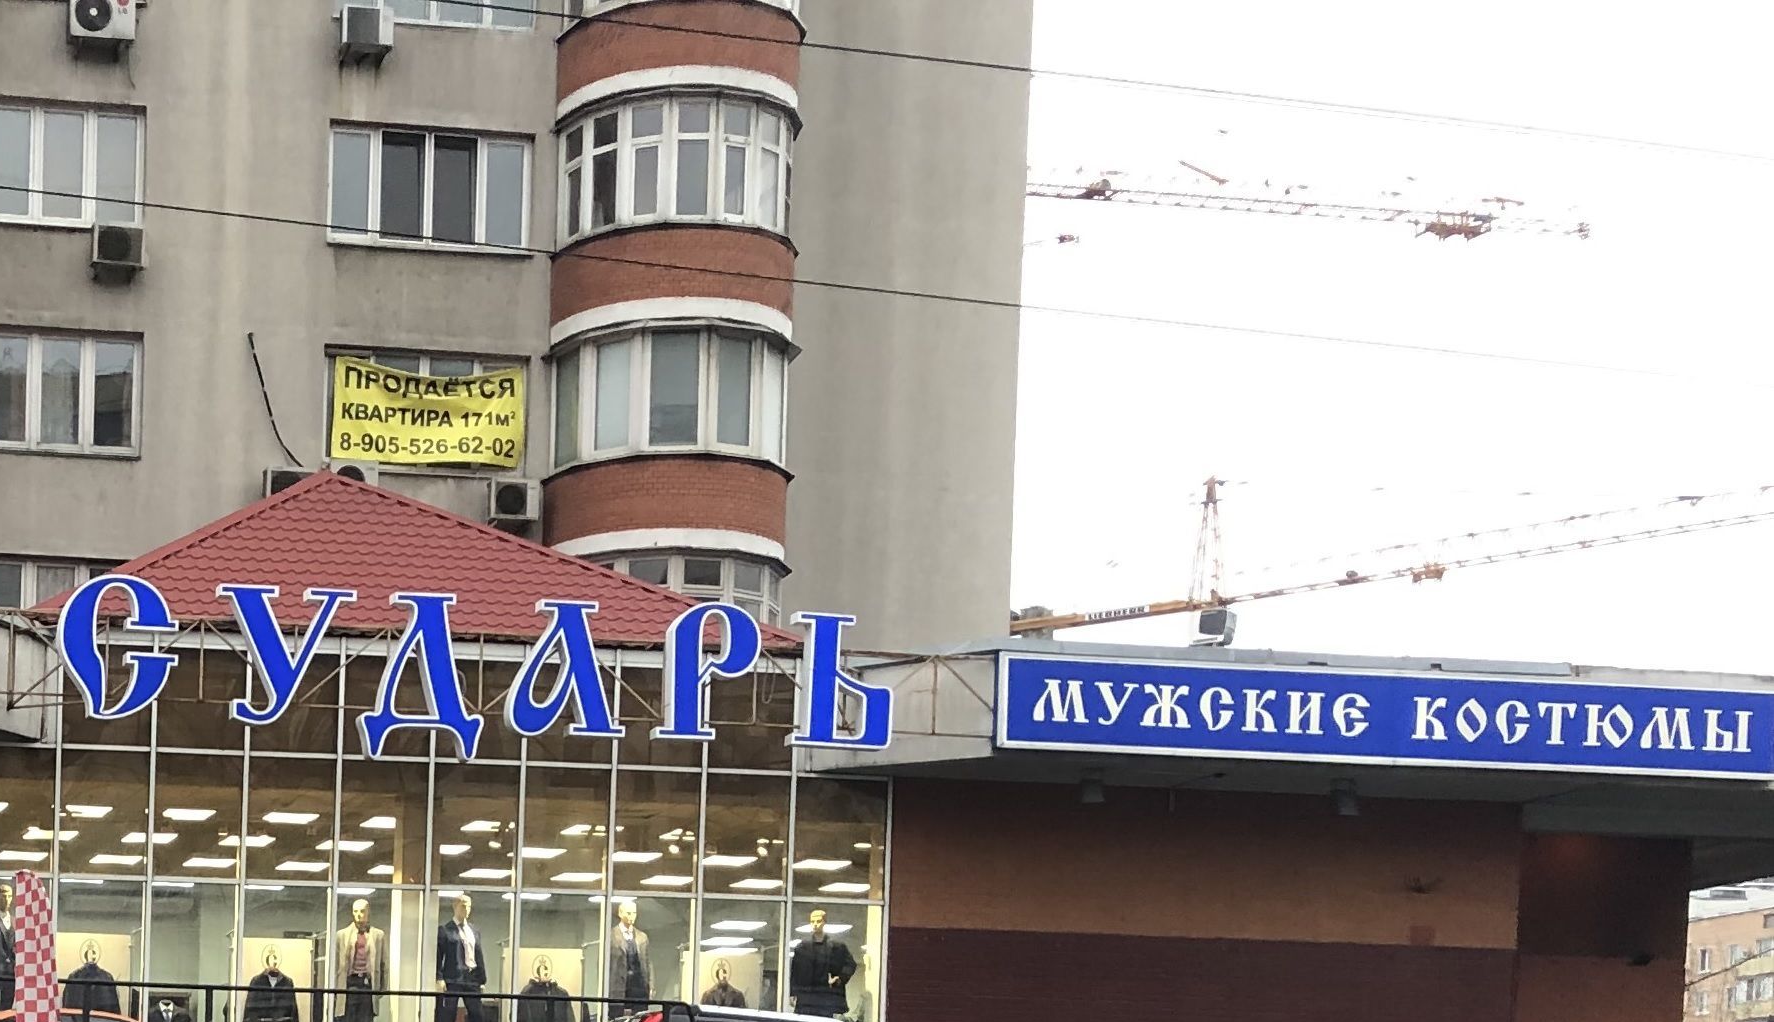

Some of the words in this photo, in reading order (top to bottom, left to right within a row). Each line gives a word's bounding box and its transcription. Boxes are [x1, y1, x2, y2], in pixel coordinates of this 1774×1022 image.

[344, 366, 515, 399] ПРОДАЁТСЯ
[341, 402, 453, 428] КВАРТИРА
[339, 432, 516, 459] 8-905-526-62-02
[55, 573, 893, 764] СУДАРЬ
[1032, 678, 1371, 738] МУЖСКИЕ
[1410, 695, 1754, 753] КОСТЮМЫ
